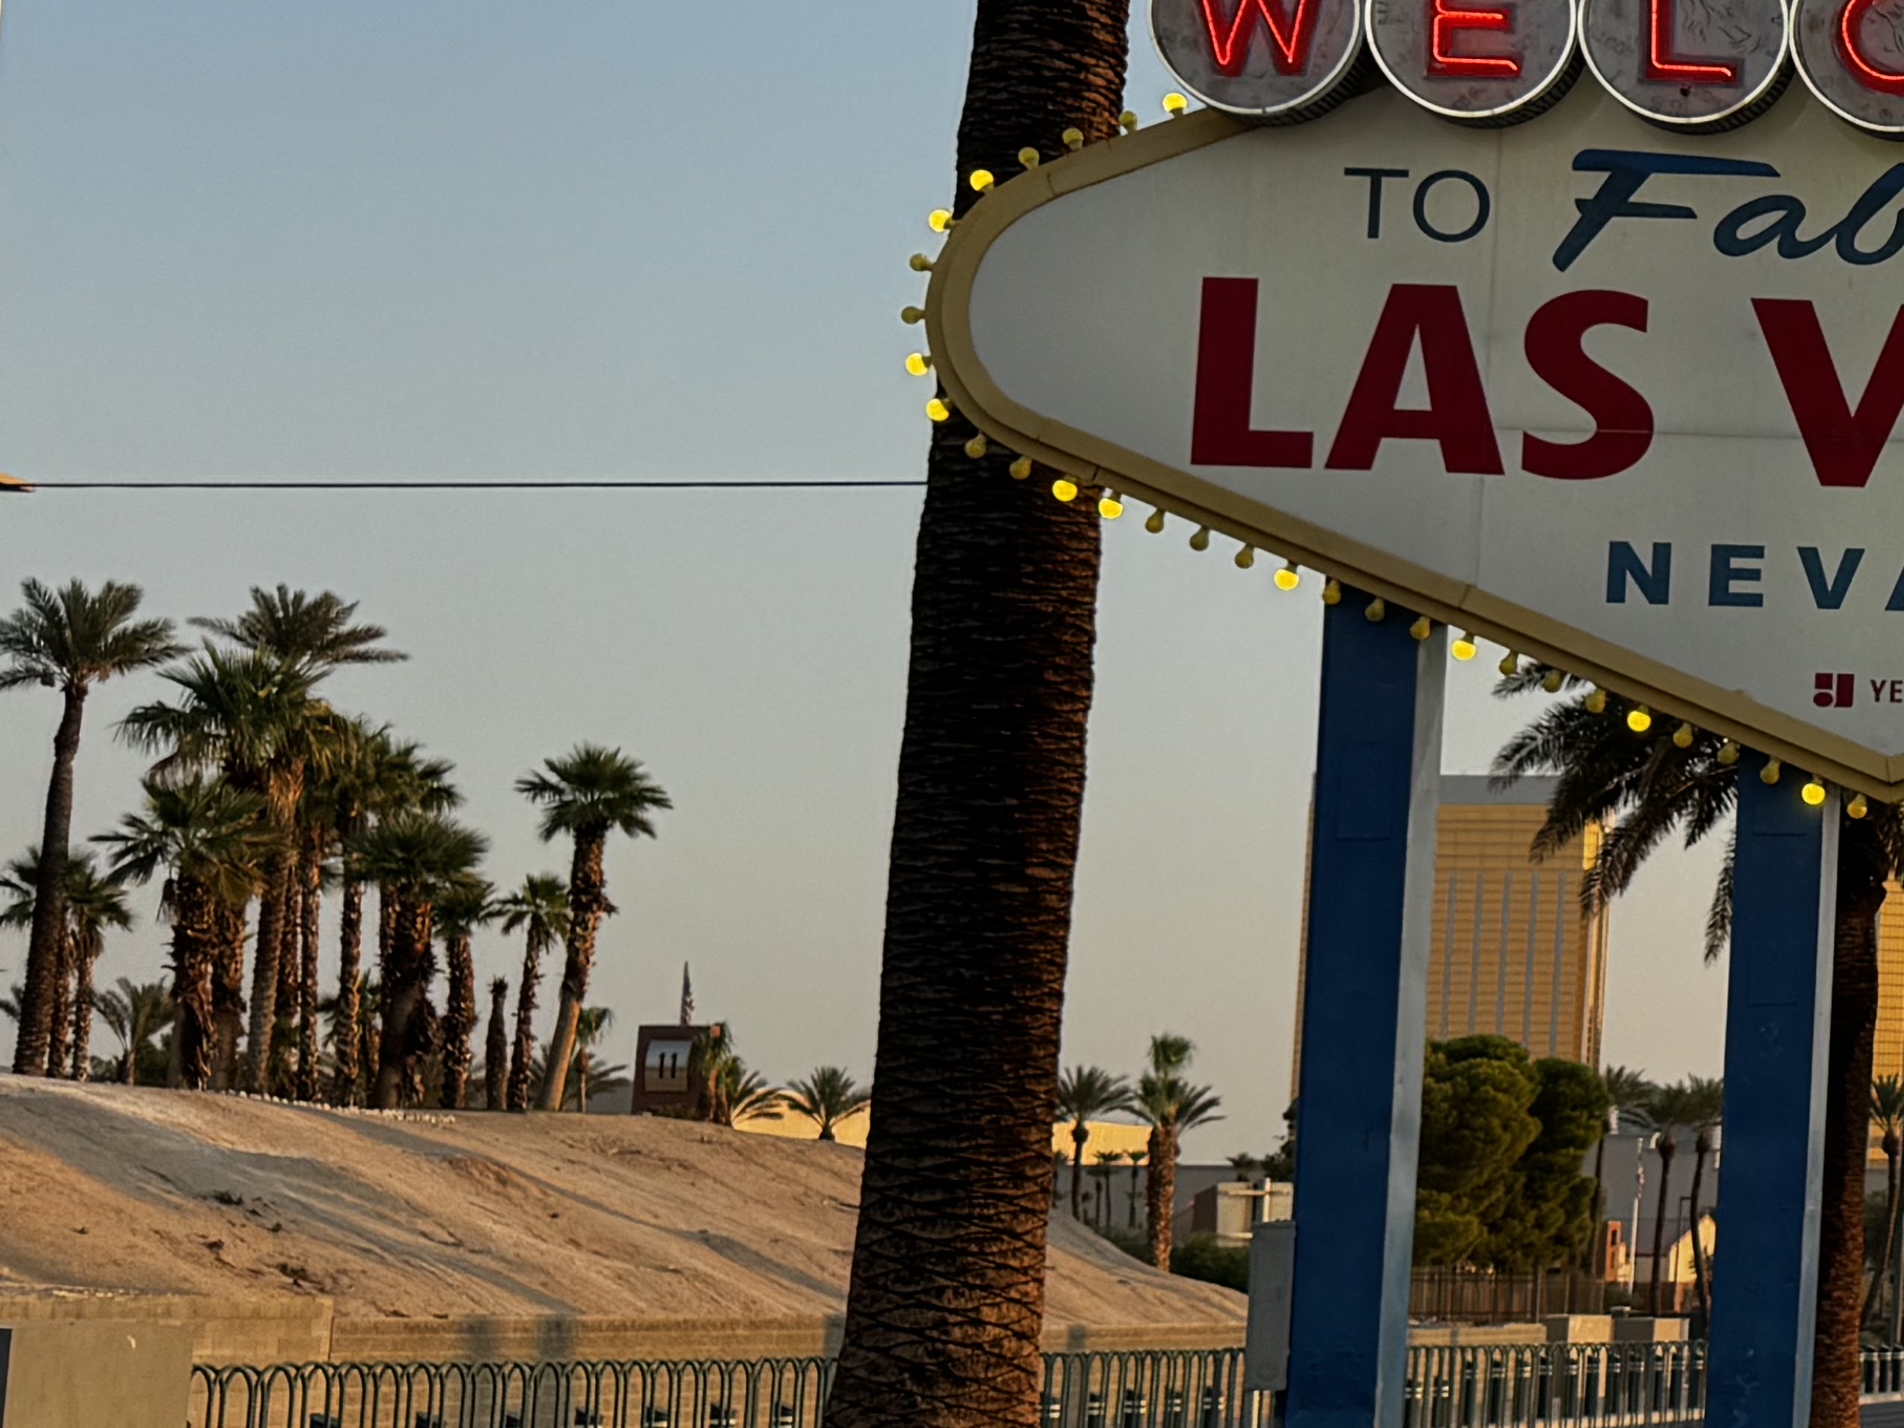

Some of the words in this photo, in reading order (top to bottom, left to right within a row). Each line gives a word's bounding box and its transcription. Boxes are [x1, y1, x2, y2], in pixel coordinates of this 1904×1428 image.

[1343, 166, 1491, 243] TO
[1190, 276, 1656, 480] LAS
[658, 1052, 678, 1079] 11
